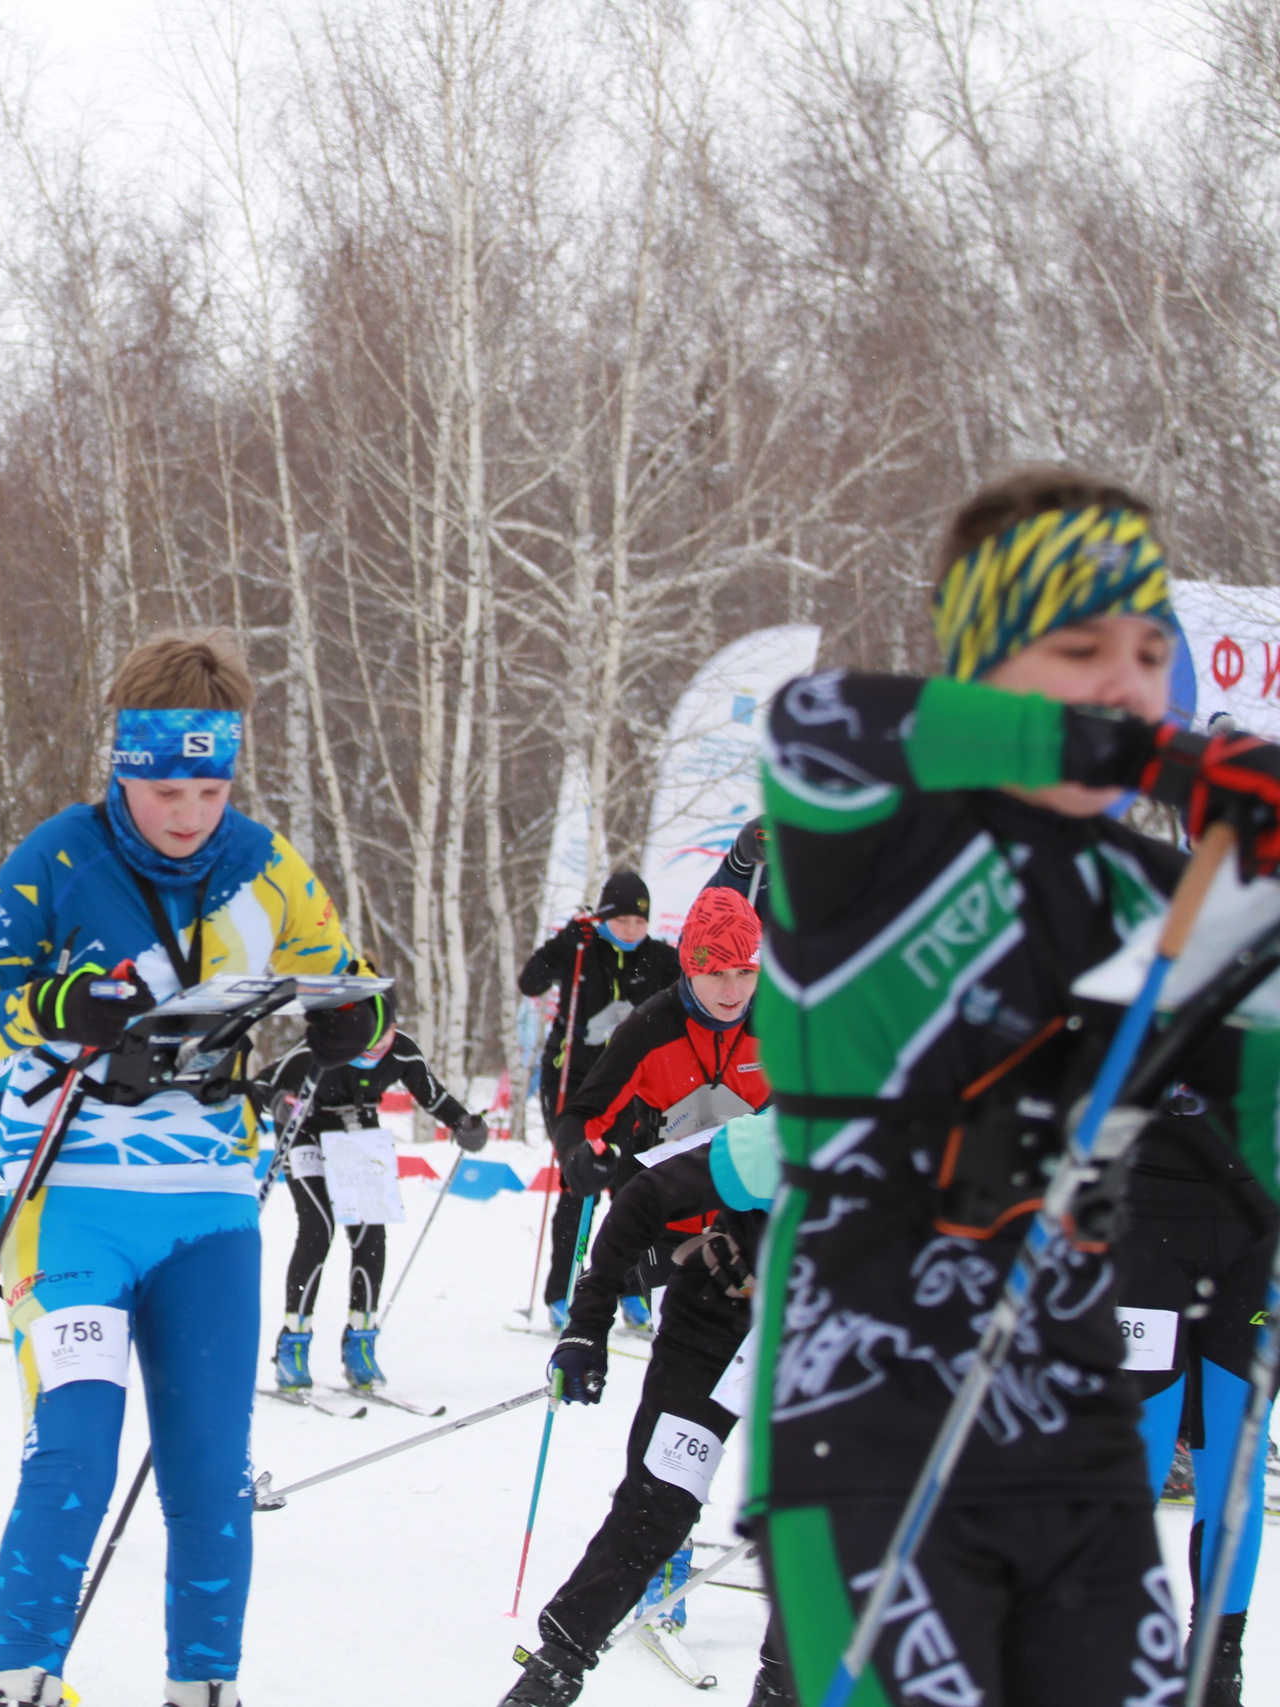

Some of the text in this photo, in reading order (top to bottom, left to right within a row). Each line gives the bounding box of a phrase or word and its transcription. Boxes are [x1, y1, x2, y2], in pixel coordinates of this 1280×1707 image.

[188, 736, 210, 753] S
[53, 1320, 104, 1346] 758
[1120, 1320, 1145, 1339] 66
[673, 1431, 710, 1463] 768
